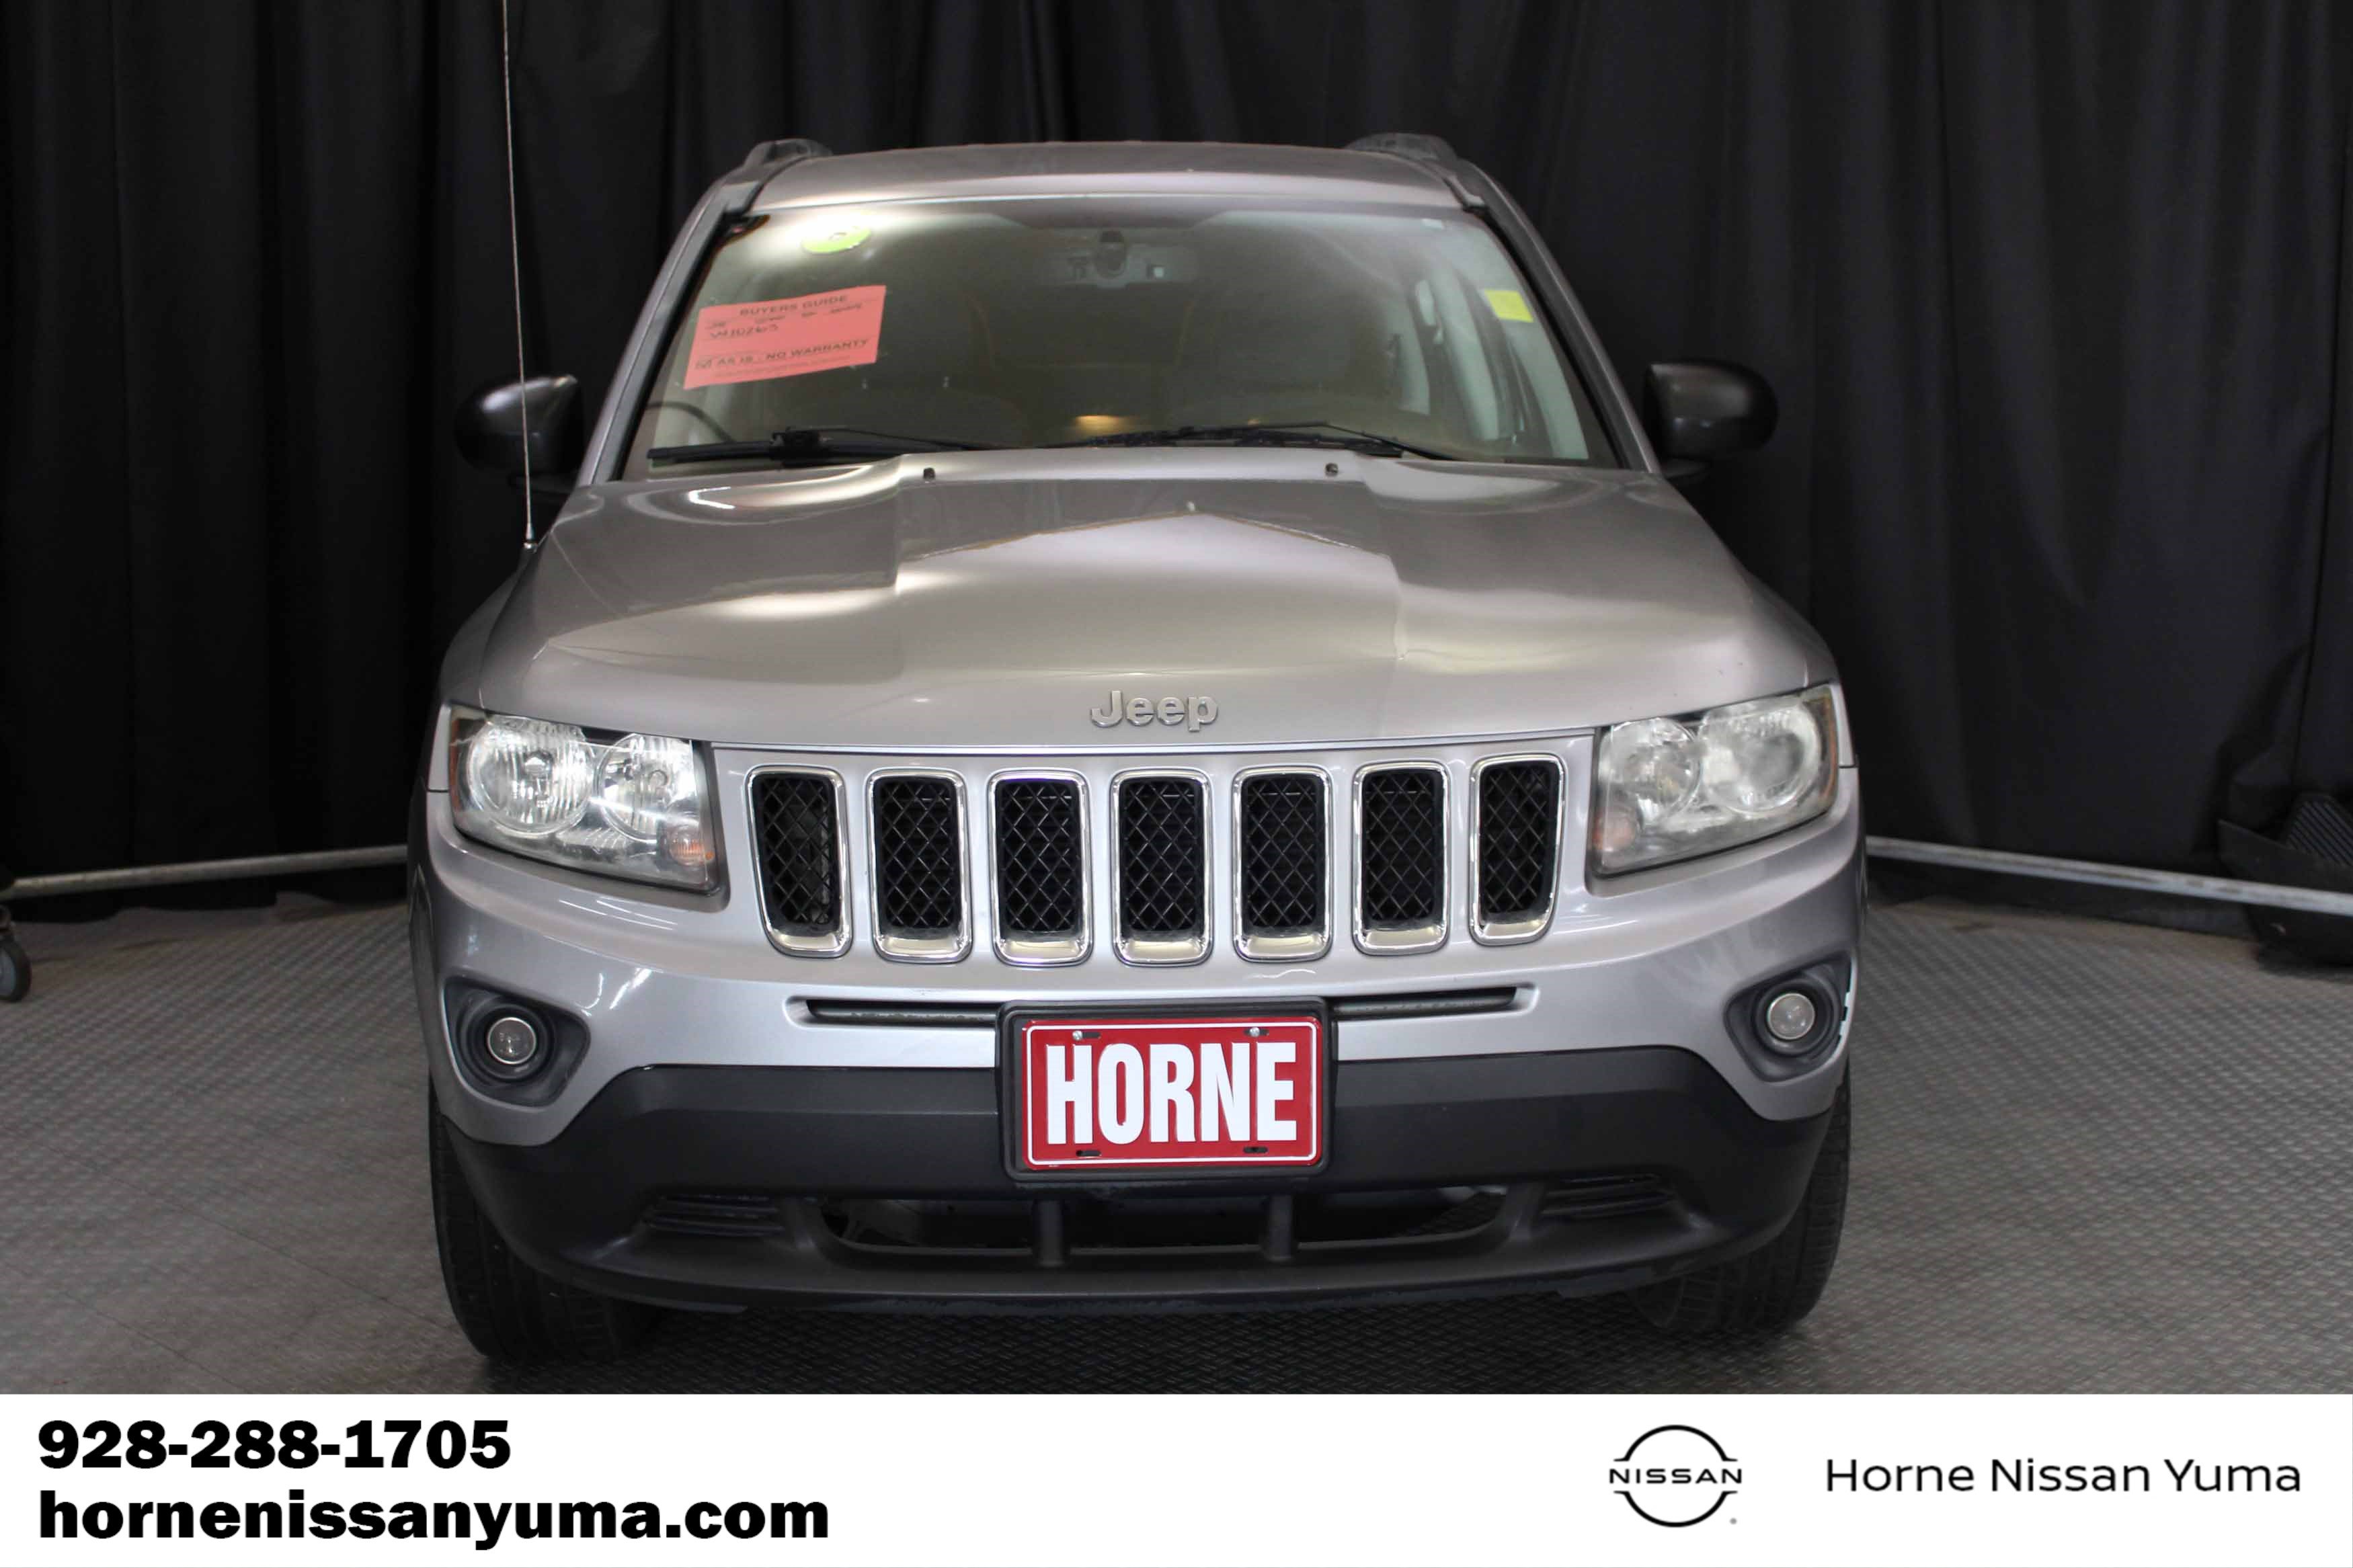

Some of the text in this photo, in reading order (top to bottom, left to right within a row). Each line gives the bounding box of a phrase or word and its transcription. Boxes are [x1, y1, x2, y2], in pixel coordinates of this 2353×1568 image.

[766, 350, 786, 360] NO
[1090, 690, 1218, 733] Jeep
[1045, 1042, 1297, 1145] HORNE
